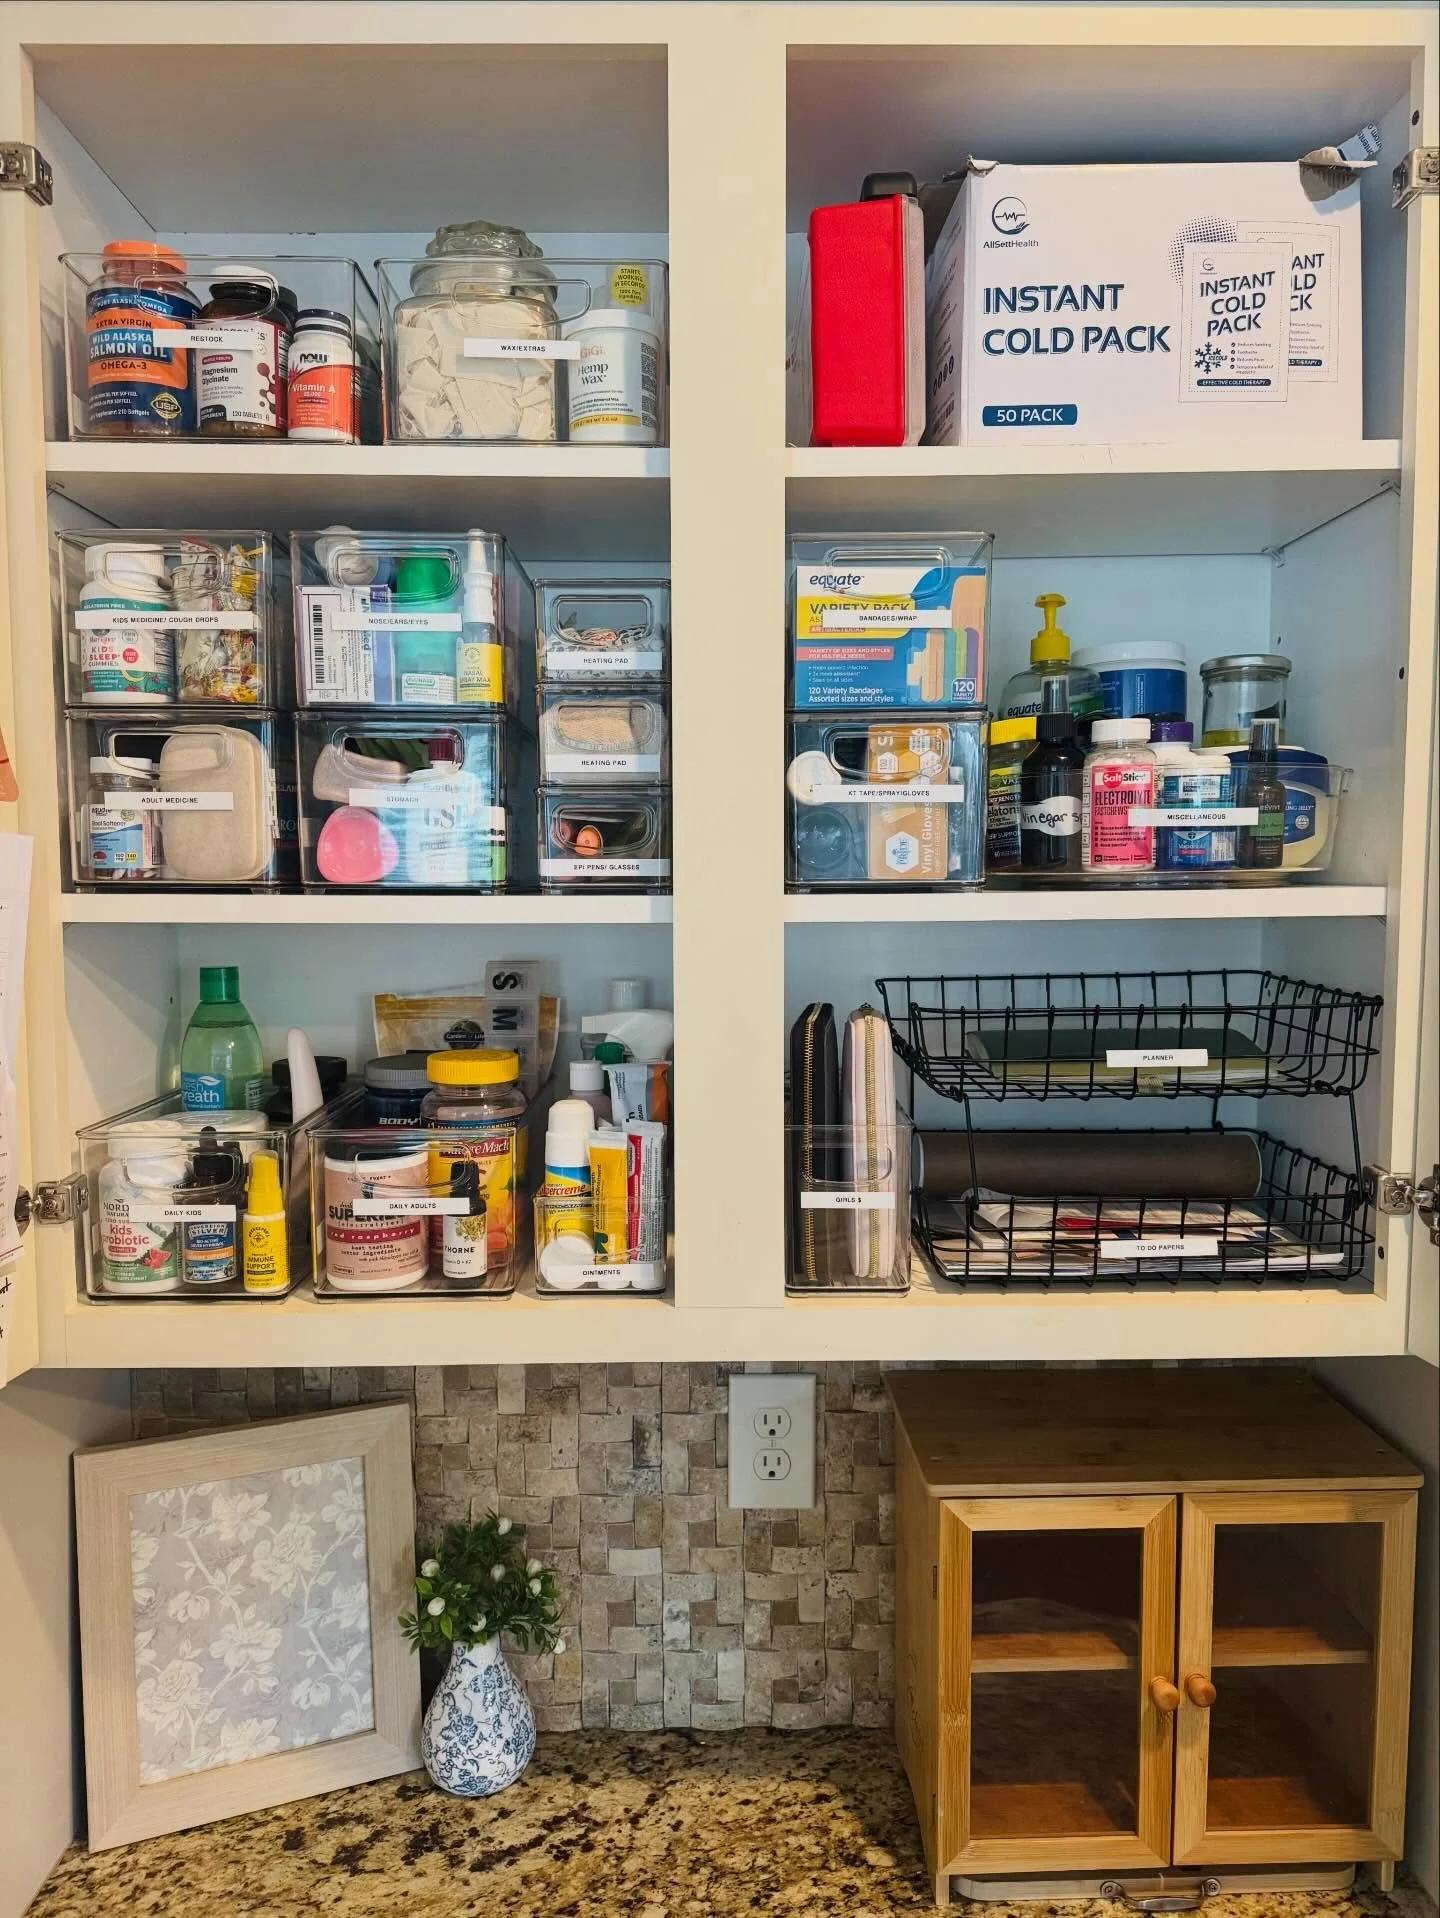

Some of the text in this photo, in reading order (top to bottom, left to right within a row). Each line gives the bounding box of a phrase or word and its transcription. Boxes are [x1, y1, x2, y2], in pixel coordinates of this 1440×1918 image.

[983, 239, 1039, 249] AllSettHealth
[1200, 270, 1276, 297] INSTANT
[983, 283, 1125, 315] INSTANT
[1211, 292, 1266, 315] COLD
[141, 300, 168, 314] OMEGA
[96, 318, 152, 329] EXTRA VIRGIN
[1207, 312, 1262, 337] PACK
[92, 333, 110, 344] WILD
[982, 325, 1171, 356] COLD PACK
[90, 342, 168, 359] SALMON OIL
[100, 360, 147, 370] OMEGA-3
[577, 363, 609, 376] Hemp
[292, 383, 336, 393] Vitamin A
[155, 402, 178, 411] USP
[996, 408, 1064, 422] 50 PACK
[809, 573, 861, 589] equate
[89, 653, 118, 661] SLEEP
[808, 686, 884, 695] 120 Variety Bandages
[953, 680, 975, 692] 120
[871, 696, 894, 704] styles
[1007, 701, 1042, 718] equate
[386, 795, 419, 803] STOMACH
[1022, 812, 1068, 828] Vinegar
[921, 801, 935, 875] Vinyl Gloves
[492, 972, 518, 991] S
[492, 1008, 518, 1031] M
[378, 1117, 420, 1126] BODY
[110, 1224, 132, 1235] kids
[192, 1227, 225, 1235] SILVER
[443, 1245, 476, 1254] THORNE
[248, 1255, 275, 1263] IMMUNE
[246, 1262, 276, 1270] SUPPORT
